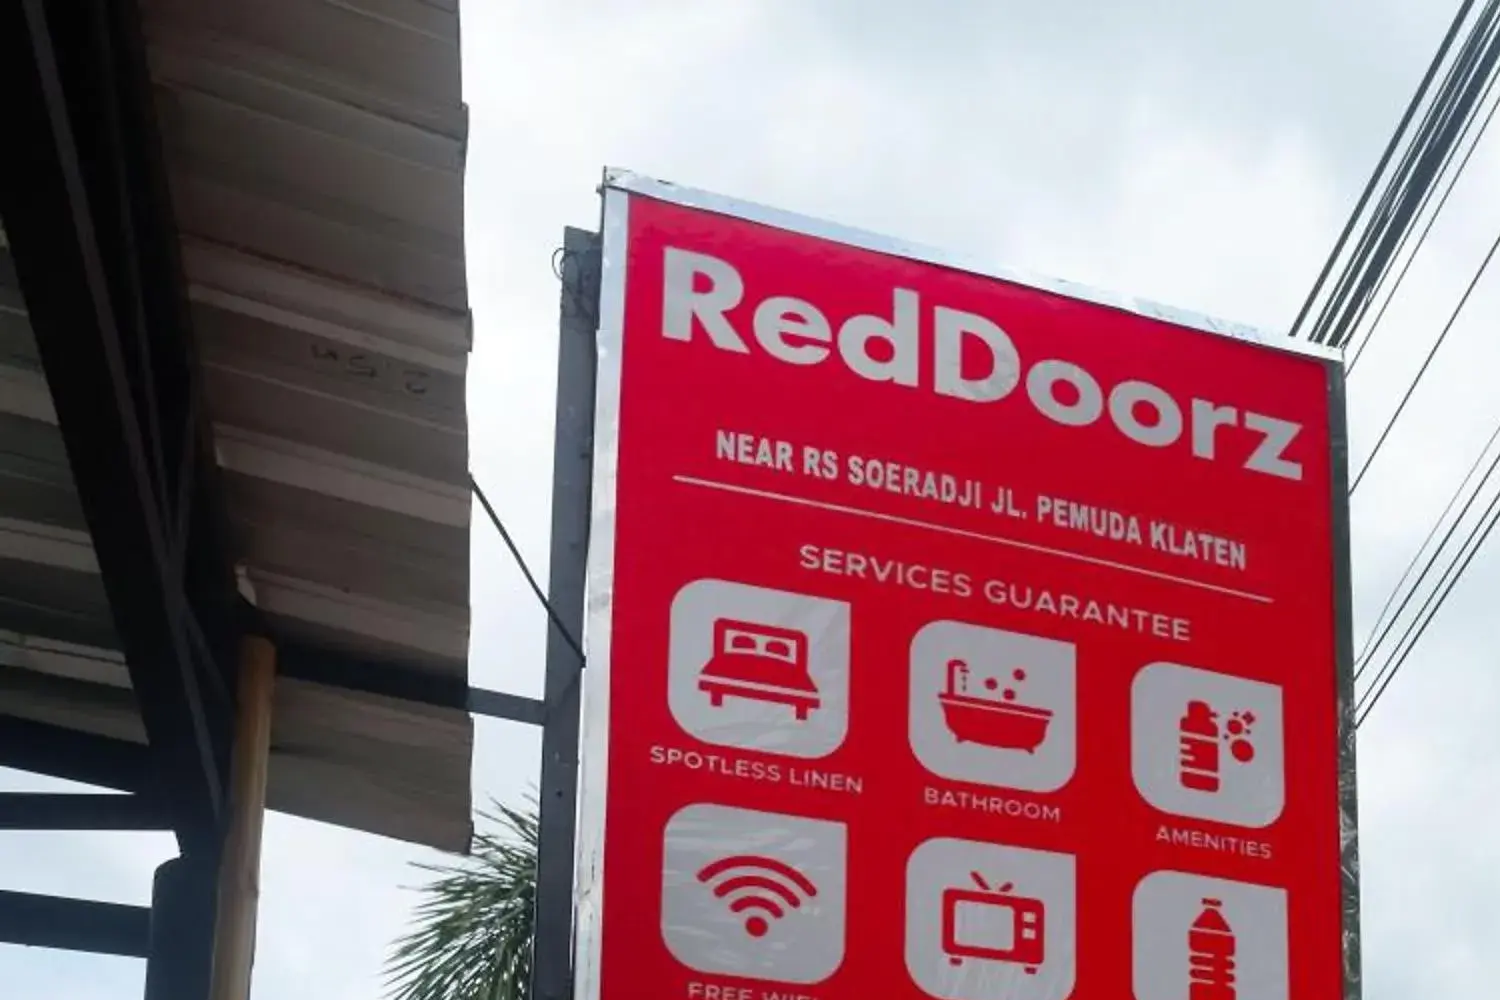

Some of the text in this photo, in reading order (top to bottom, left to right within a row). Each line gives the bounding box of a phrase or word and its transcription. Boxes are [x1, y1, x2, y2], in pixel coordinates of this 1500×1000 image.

[662, 246, 1303, 481] RedDoorz
[716, 430, 1246, 570] NEAR RS SOERADJI JL. PEMUDA KLATEN
[799, 544, 1190, 642] SERVICES GUARANTEE
[650, 744, 863, 793] SPOTLESS LINEN
[924, 787, 1060, 823] BATHROOM
[1156, 826, 1271, 859] AMENITIES
